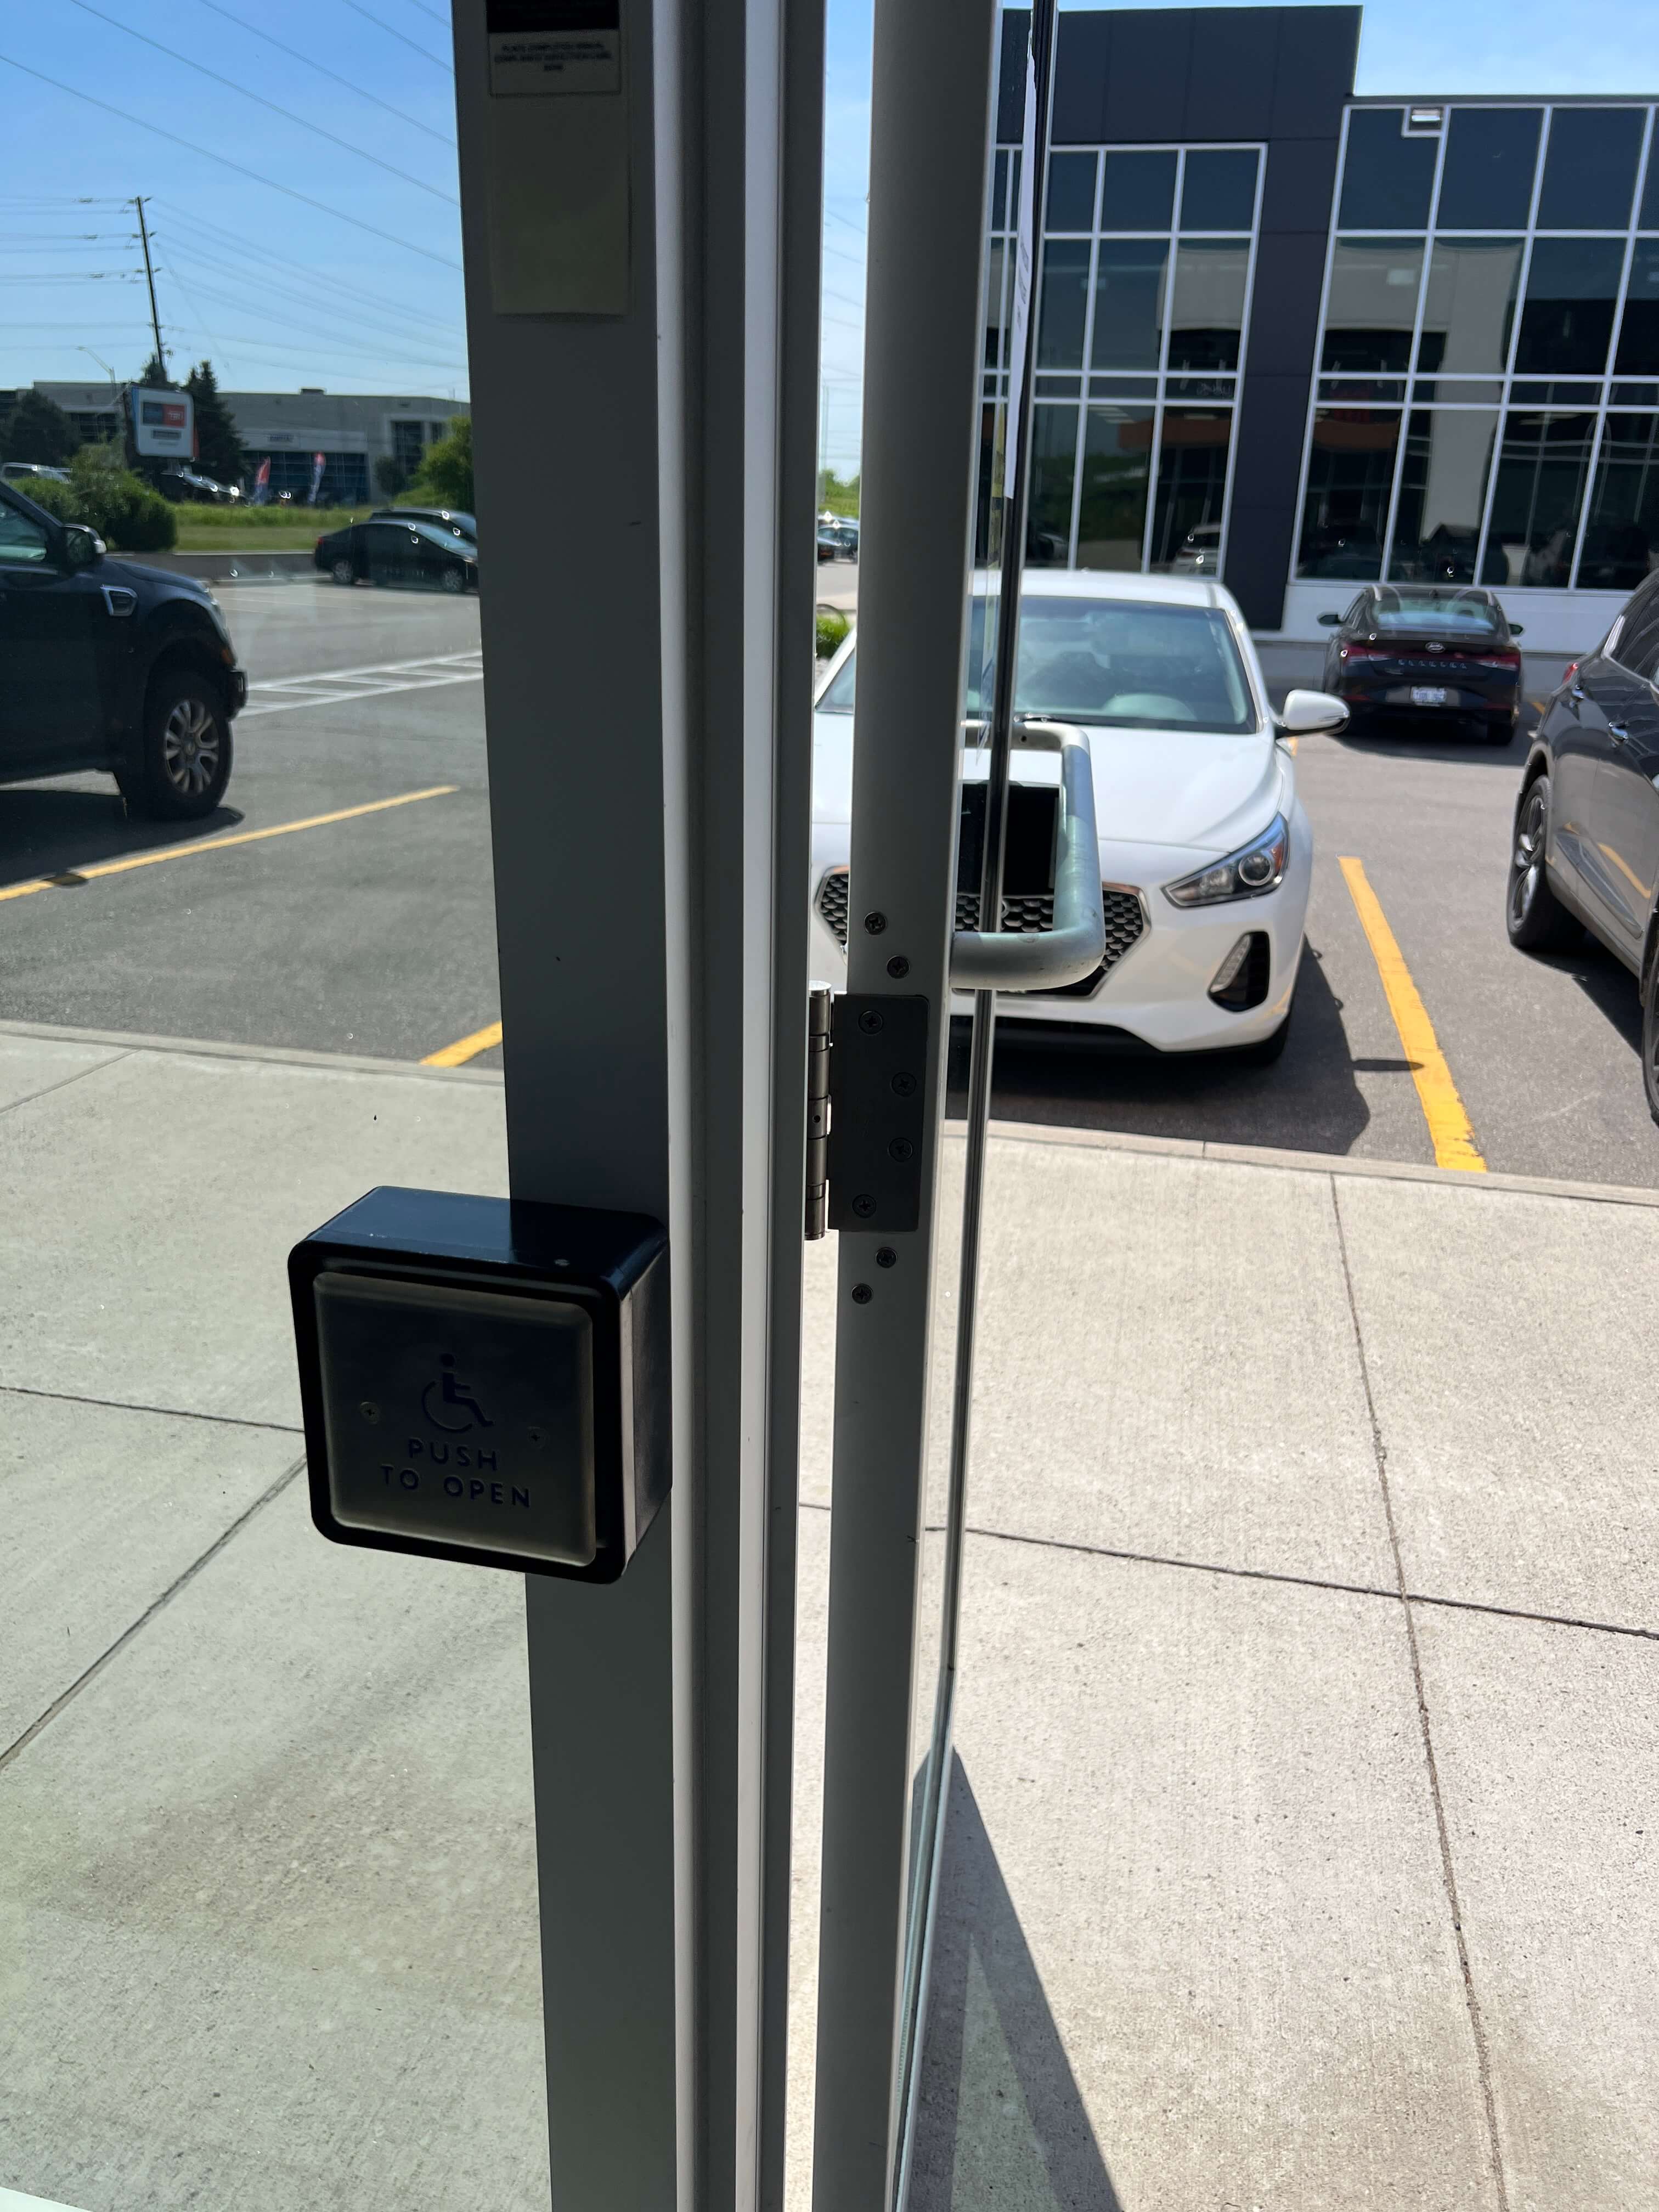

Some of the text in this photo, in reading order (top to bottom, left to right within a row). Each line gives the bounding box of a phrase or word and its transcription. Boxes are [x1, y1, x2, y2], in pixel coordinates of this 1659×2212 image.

[408, 1437, 497, 1471] PUSH
[380, 1464, 531, 1508] TO OPEN
